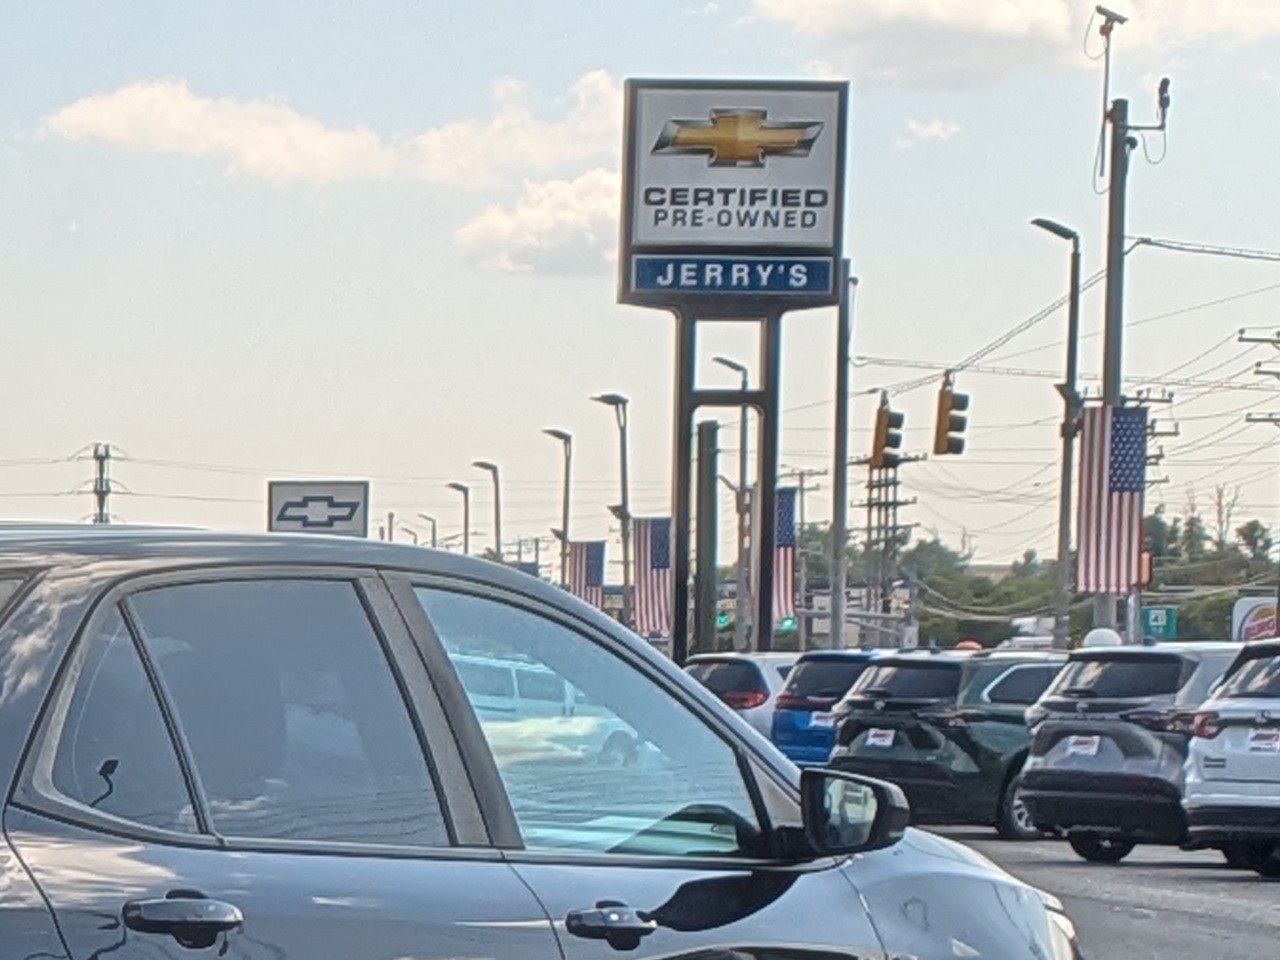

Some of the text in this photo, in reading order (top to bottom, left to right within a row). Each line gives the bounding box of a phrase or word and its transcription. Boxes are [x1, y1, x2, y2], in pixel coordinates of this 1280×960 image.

[644, 187, 829, 207] CERTIFIED
[653, 209, 818, 228] PRE-OWNED
[656, 263, 809, 287] JERRY'S
